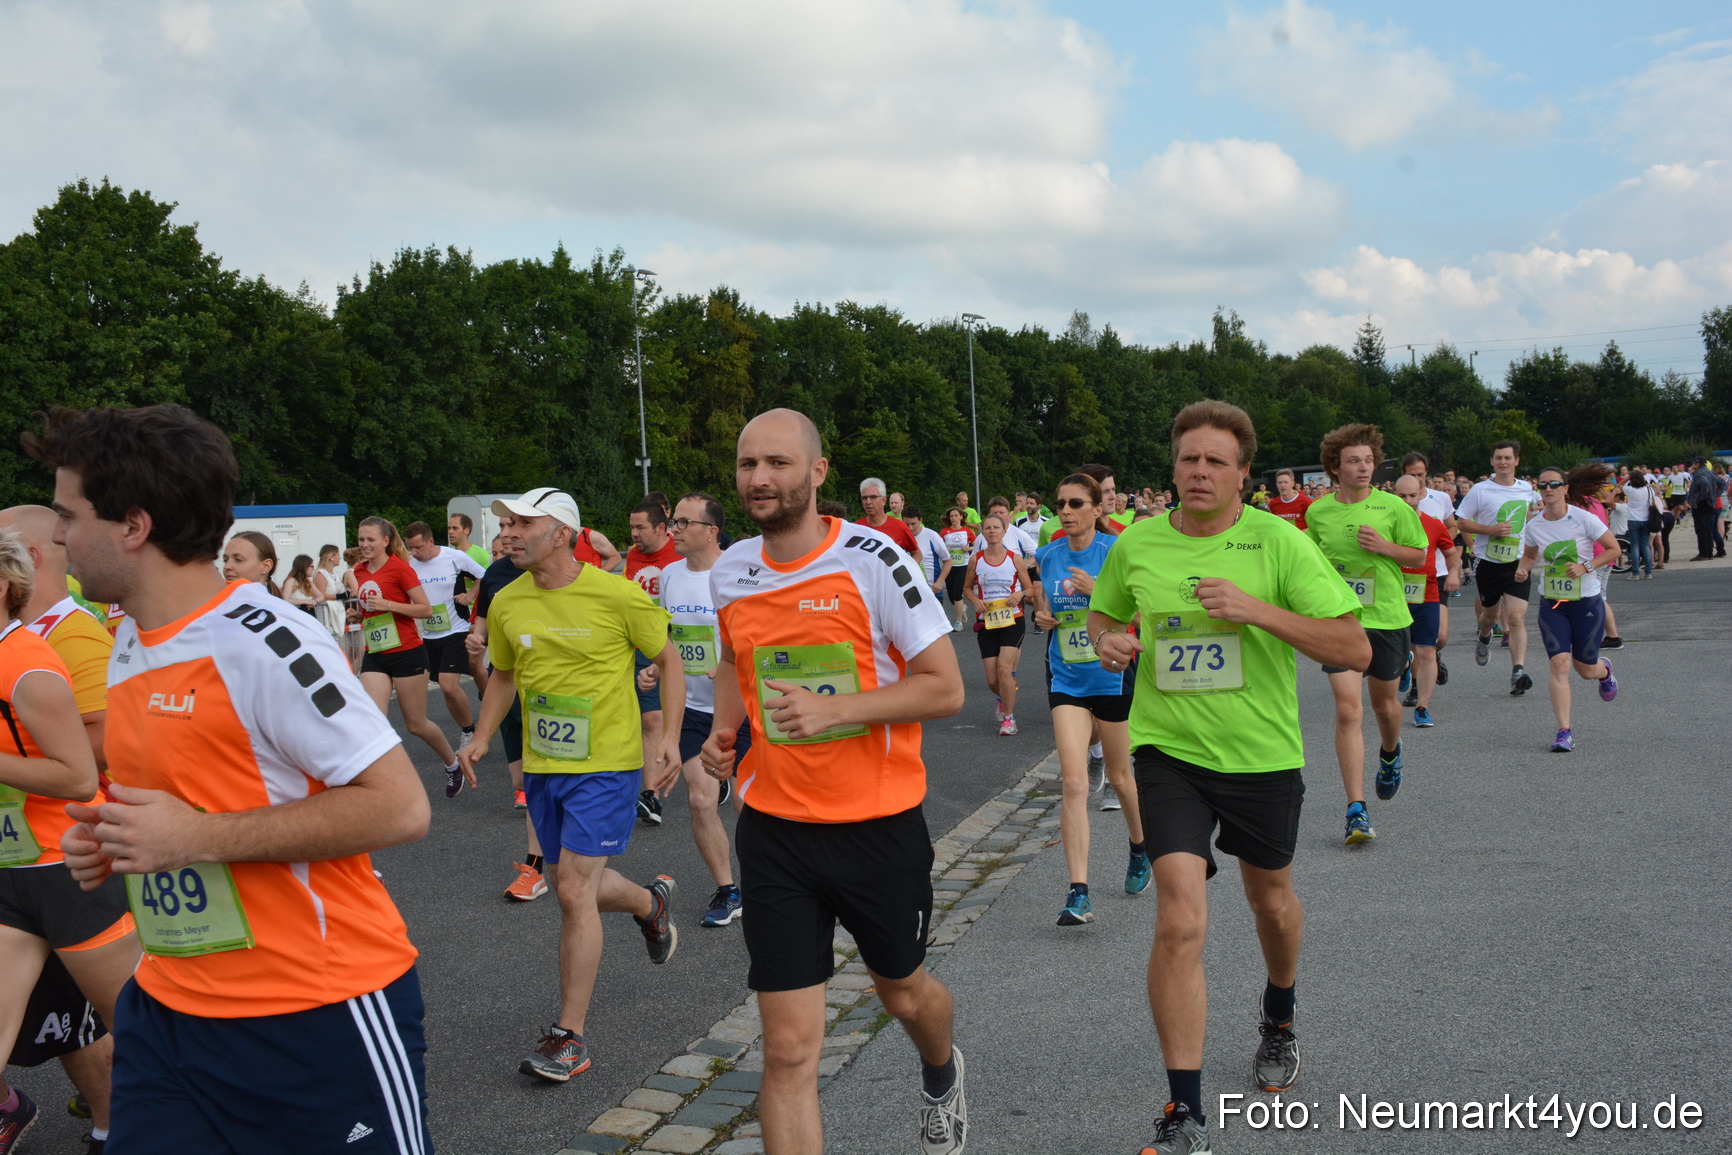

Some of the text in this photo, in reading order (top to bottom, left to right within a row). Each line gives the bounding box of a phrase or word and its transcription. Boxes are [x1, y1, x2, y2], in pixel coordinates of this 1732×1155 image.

[1236, 543, 1262, 551] DEKRA
[1494, 544, 1511, 555] 111
[420, 576, 446, 584] ELPHI
[737, 577, 759, 586] erima
[1550, 580, 1572, 591] 116
[1053, 580, 1060, 596] I
[1345, 580, 1365, 595] 76
[1404, 585, 1419, 595] 07
[1053, 594, 1088, 606] camping
[670, 605, 715, 615] DELPH
[987, 609, 1011, 622] 1112
[370, 627, 389, 642] 497
[1069, 630, 1090, 648] 45
[679, 644, 705, 661] 289
[1169, 644, 1225, 672] 273
[537, 718, 576, 744] 622
[0, 814, 18, 842] 4
[142, 867, 208, 917] 489
[183, 924, 211, 936] Meyer
